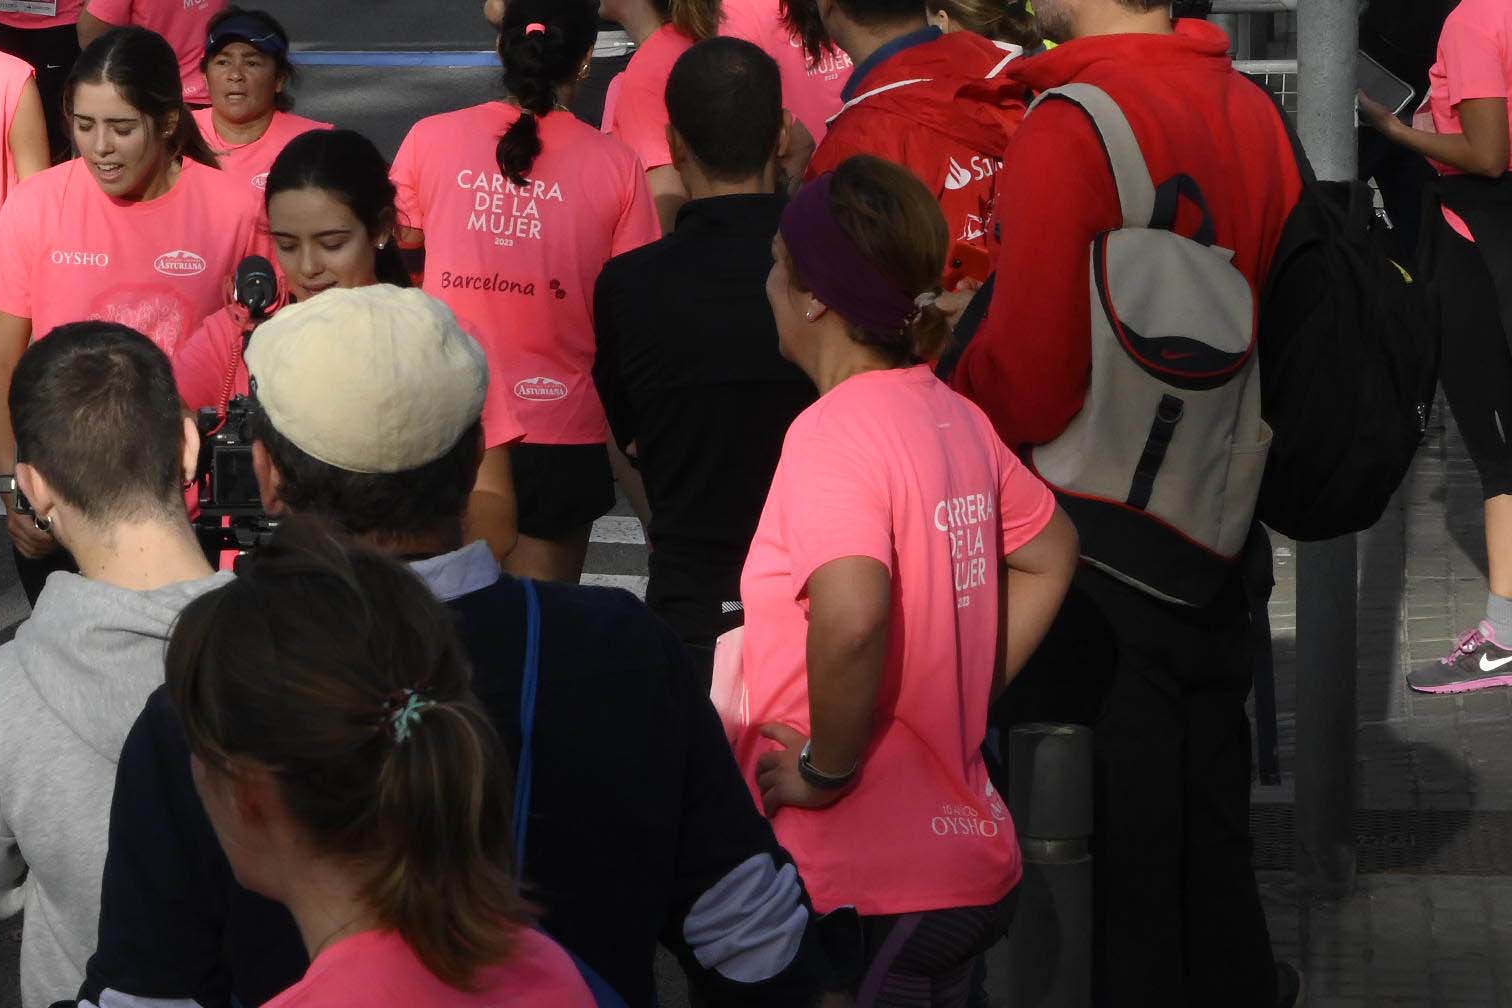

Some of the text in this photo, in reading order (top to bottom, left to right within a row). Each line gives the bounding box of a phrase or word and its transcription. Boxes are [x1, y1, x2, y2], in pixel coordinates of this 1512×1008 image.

[474, 192, 540, 219] DE LA
[467, 212, 541, 239] MUJER
[495, 237, 513, 247] 2023
[51, 250, 110, 267] OYSHO
[158, 259, 202, 271] ASTURIANA
[441, 271, 535, 296] Barcelona
[518, 385, 564, 396] ASTURIANA
[967, 526, 984, 556] LA
[931, 815, 999, 838] OYSHO
